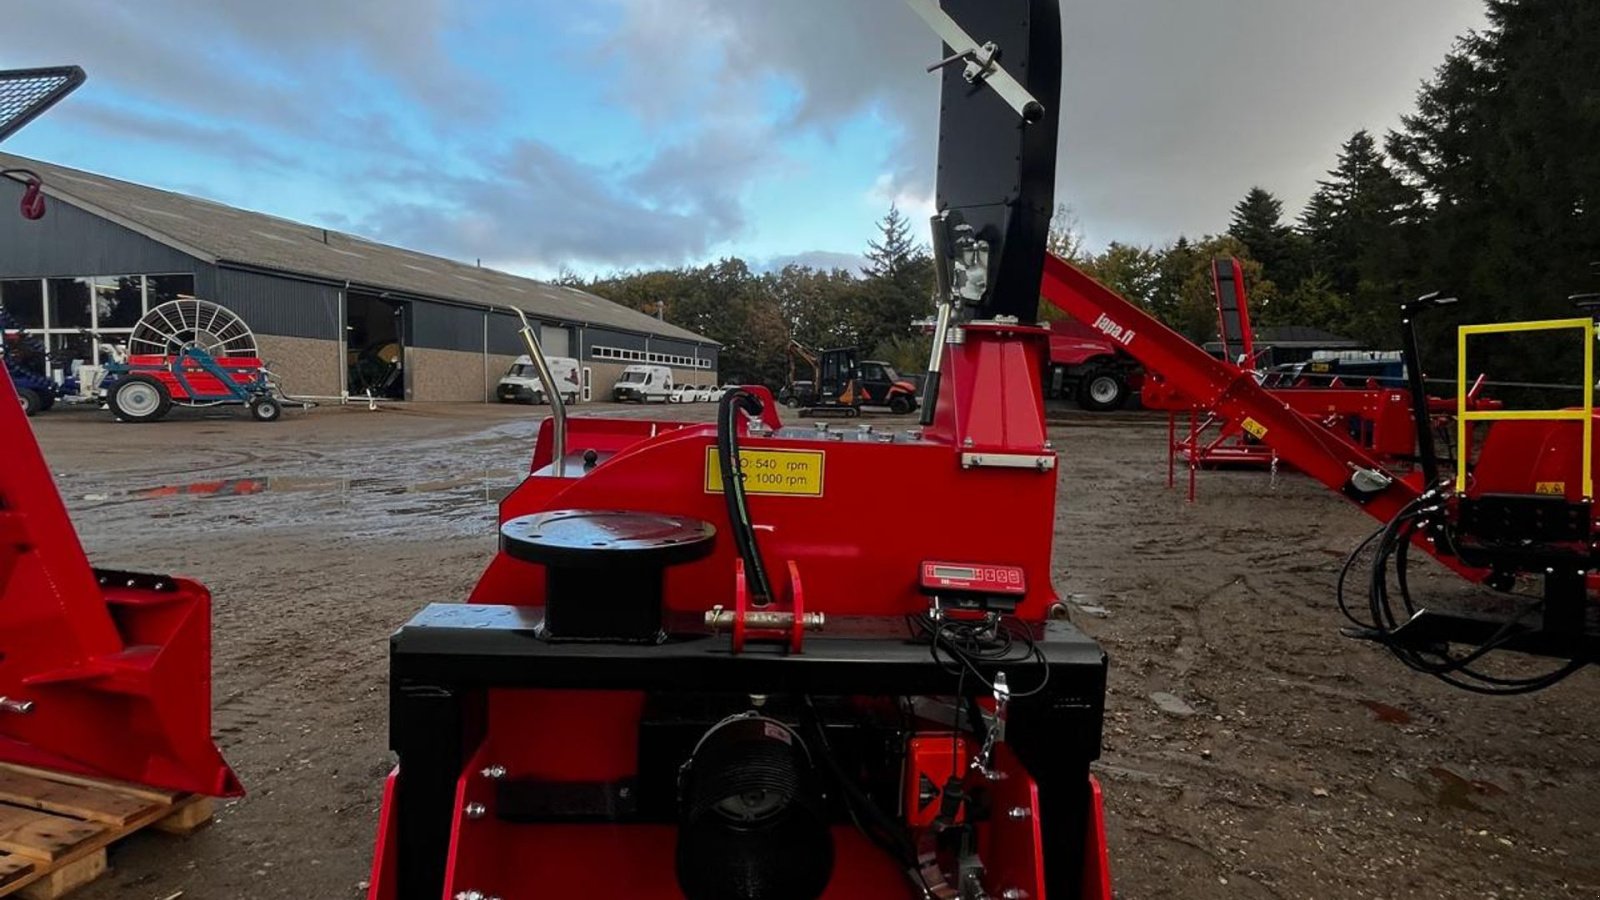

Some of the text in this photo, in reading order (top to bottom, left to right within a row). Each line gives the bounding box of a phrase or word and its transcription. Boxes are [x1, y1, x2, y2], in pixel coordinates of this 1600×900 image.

[1092, 312, 1136, 345] japa.fi
[756, 458, 777, 470] 540
[786, 462, 808, 472] rpm
[757, 473, 807, 487] 1000 rpm
